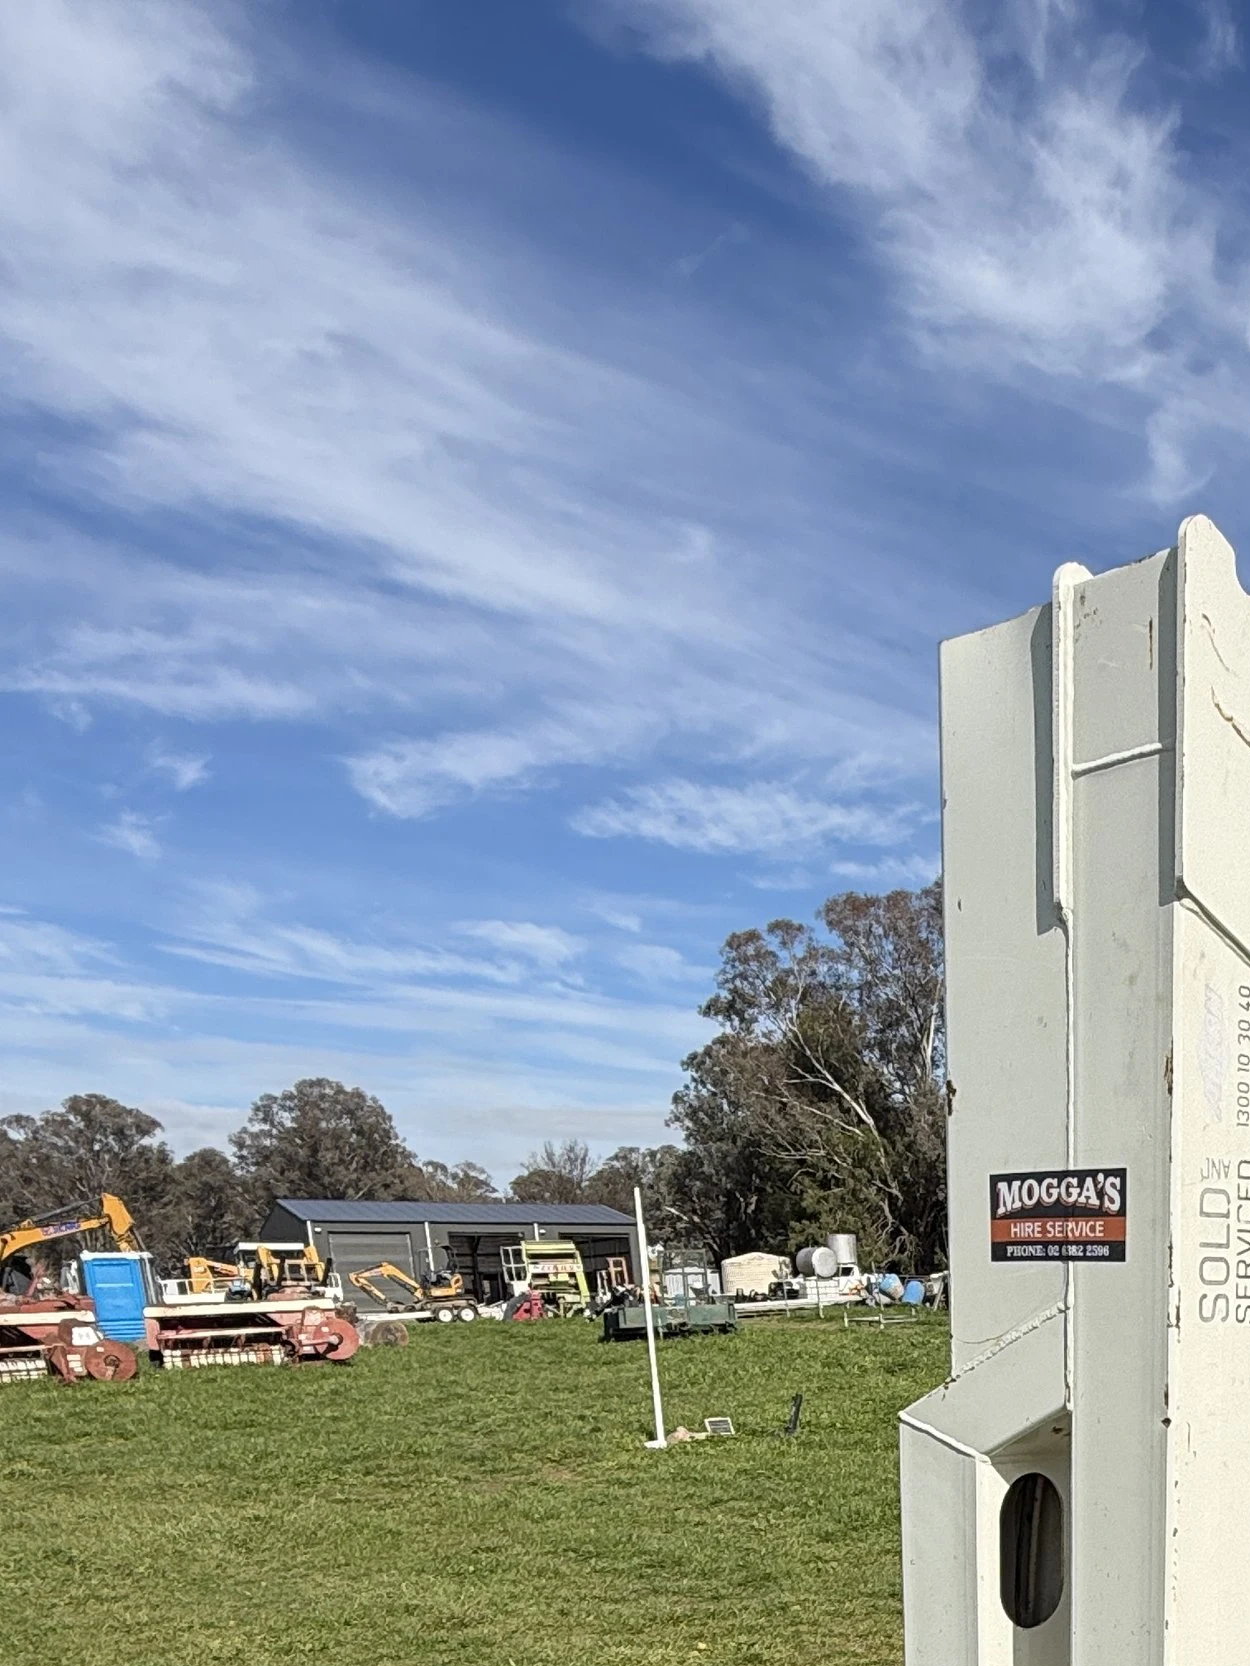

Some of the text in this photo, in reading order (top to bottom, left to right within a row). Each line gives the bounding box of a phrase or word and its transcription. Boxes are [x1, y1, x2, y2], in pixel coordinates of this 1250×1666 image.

[1238, 1018, 1250, 1045] 30
[1237, 1053, 1250, 1073] 10
[1236, 1081, 1250, 1127] 1300
[996, 1172, 1121, 1216] MOGGA'S
[1010, 1221, 1105, 1238] HIRE SERVICE
[1006, 1245, 1046, 1257] PHONE:
[1047, 1245, 1060, 1257] 02
[1086, 1244, 1110, 1257] 2596
[1199, 1187, 1231, 1323] SOLD
